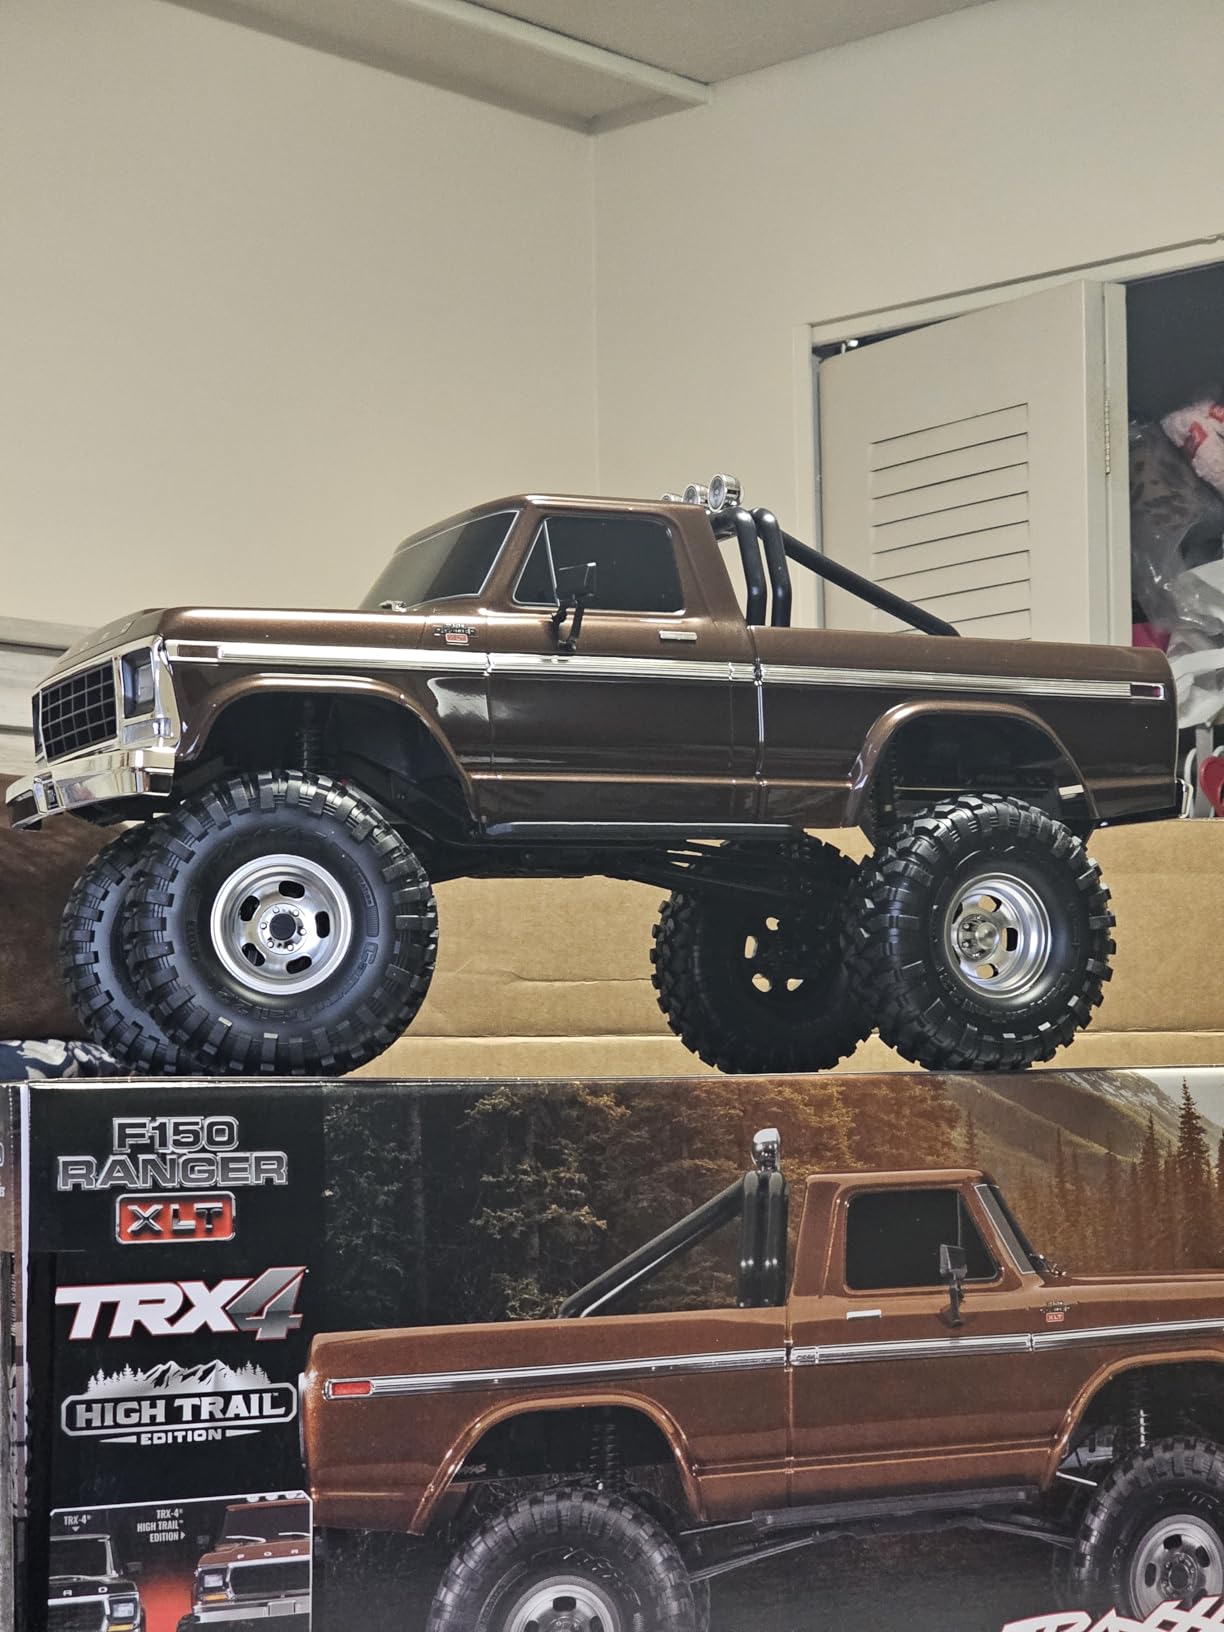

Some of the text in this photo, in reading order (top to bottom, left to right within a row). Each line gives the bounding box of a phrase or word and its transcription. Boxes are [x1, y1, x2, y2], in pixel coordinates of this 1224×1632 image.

[112, 1115, 240, 1154] F150
[57, 1150, 289, 1192] RANGER
[126, 1201, 225, 1234] XLT
[54, 1265, 307, 1341] TRX4
[75, 1398, 167, 1428] HIGH
[140, 1428, 223, 1446] EDITION
[136, 1522, 156, 1532] HIGH
[149, 1531, 179, 1543] EDITION
